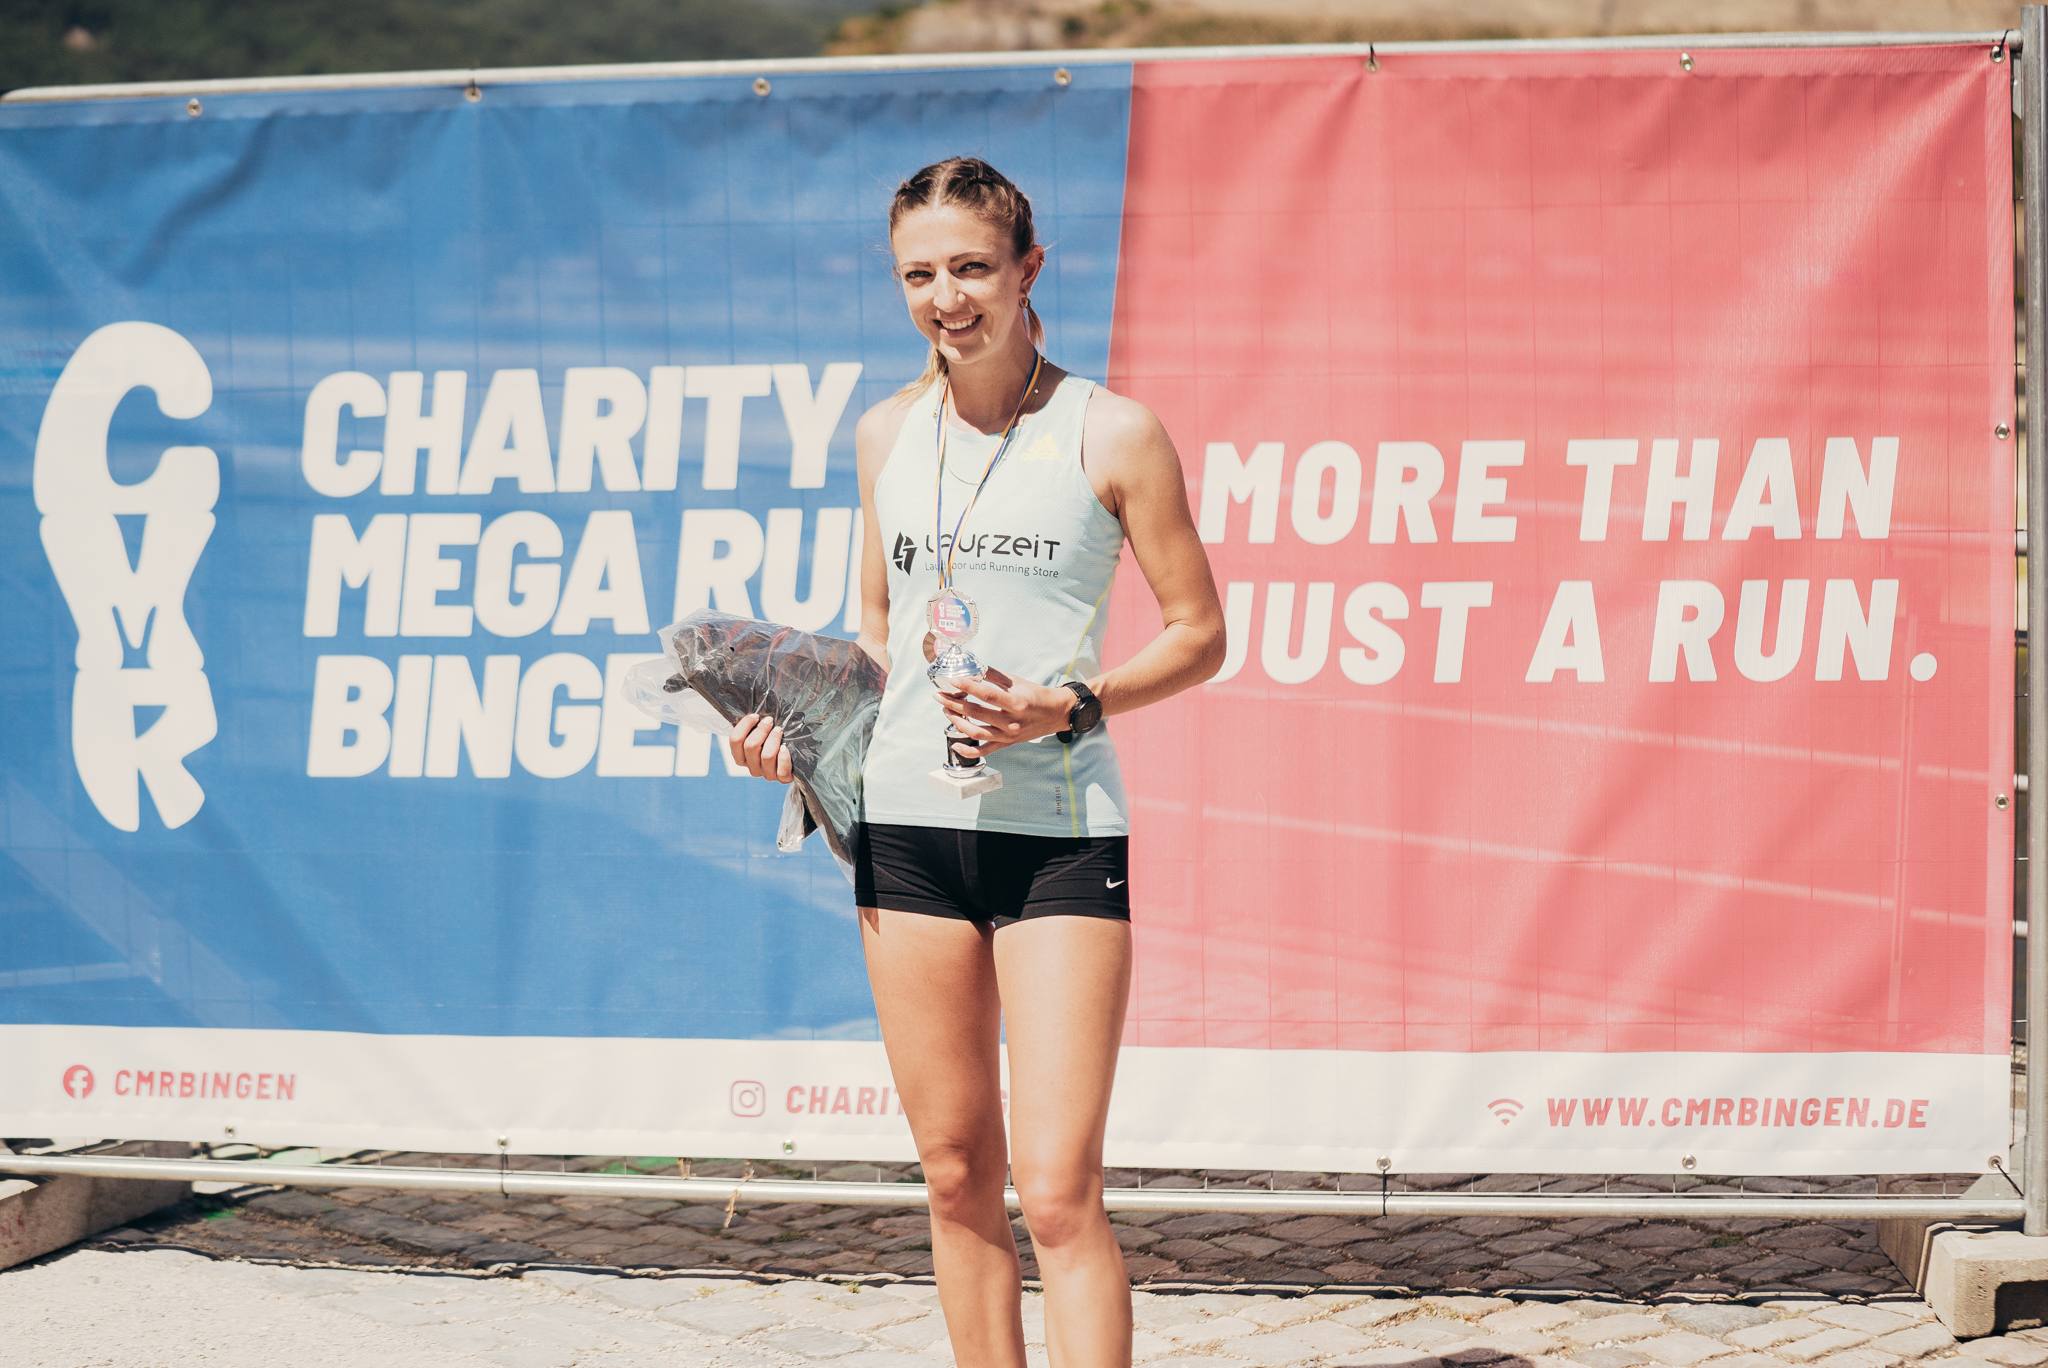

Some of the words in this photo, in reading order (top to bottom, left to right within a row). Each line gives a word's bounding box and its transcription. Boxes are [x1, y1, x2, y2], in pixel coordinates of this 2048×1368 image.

[302, 362, 862, 498] CHARITY
[1020, 450, 1062, 461] adidas
[1199, 440, 1526, 545] MORE
[1566, 436, 1901, 542] THAN
[303, 510, 650, 638] MEGA
[673, 507, 863, 633] RU
[969, 561, 987, 571] und
[989, 561, 1030, 576] Running
[1032, 565, 1059, 578] Store
[1204, 580, 1494, 685] JUST
[1525, 579, 1606, 683] A
[1648, 578, 1938, 683] RUN.
[115, 1069, 297, 1101] CMRBINGEN
[786, 1085, 905, 1116] CHARI
[1546, 1096, 1930, 1129] WWW.CMRBINGEN.DE
